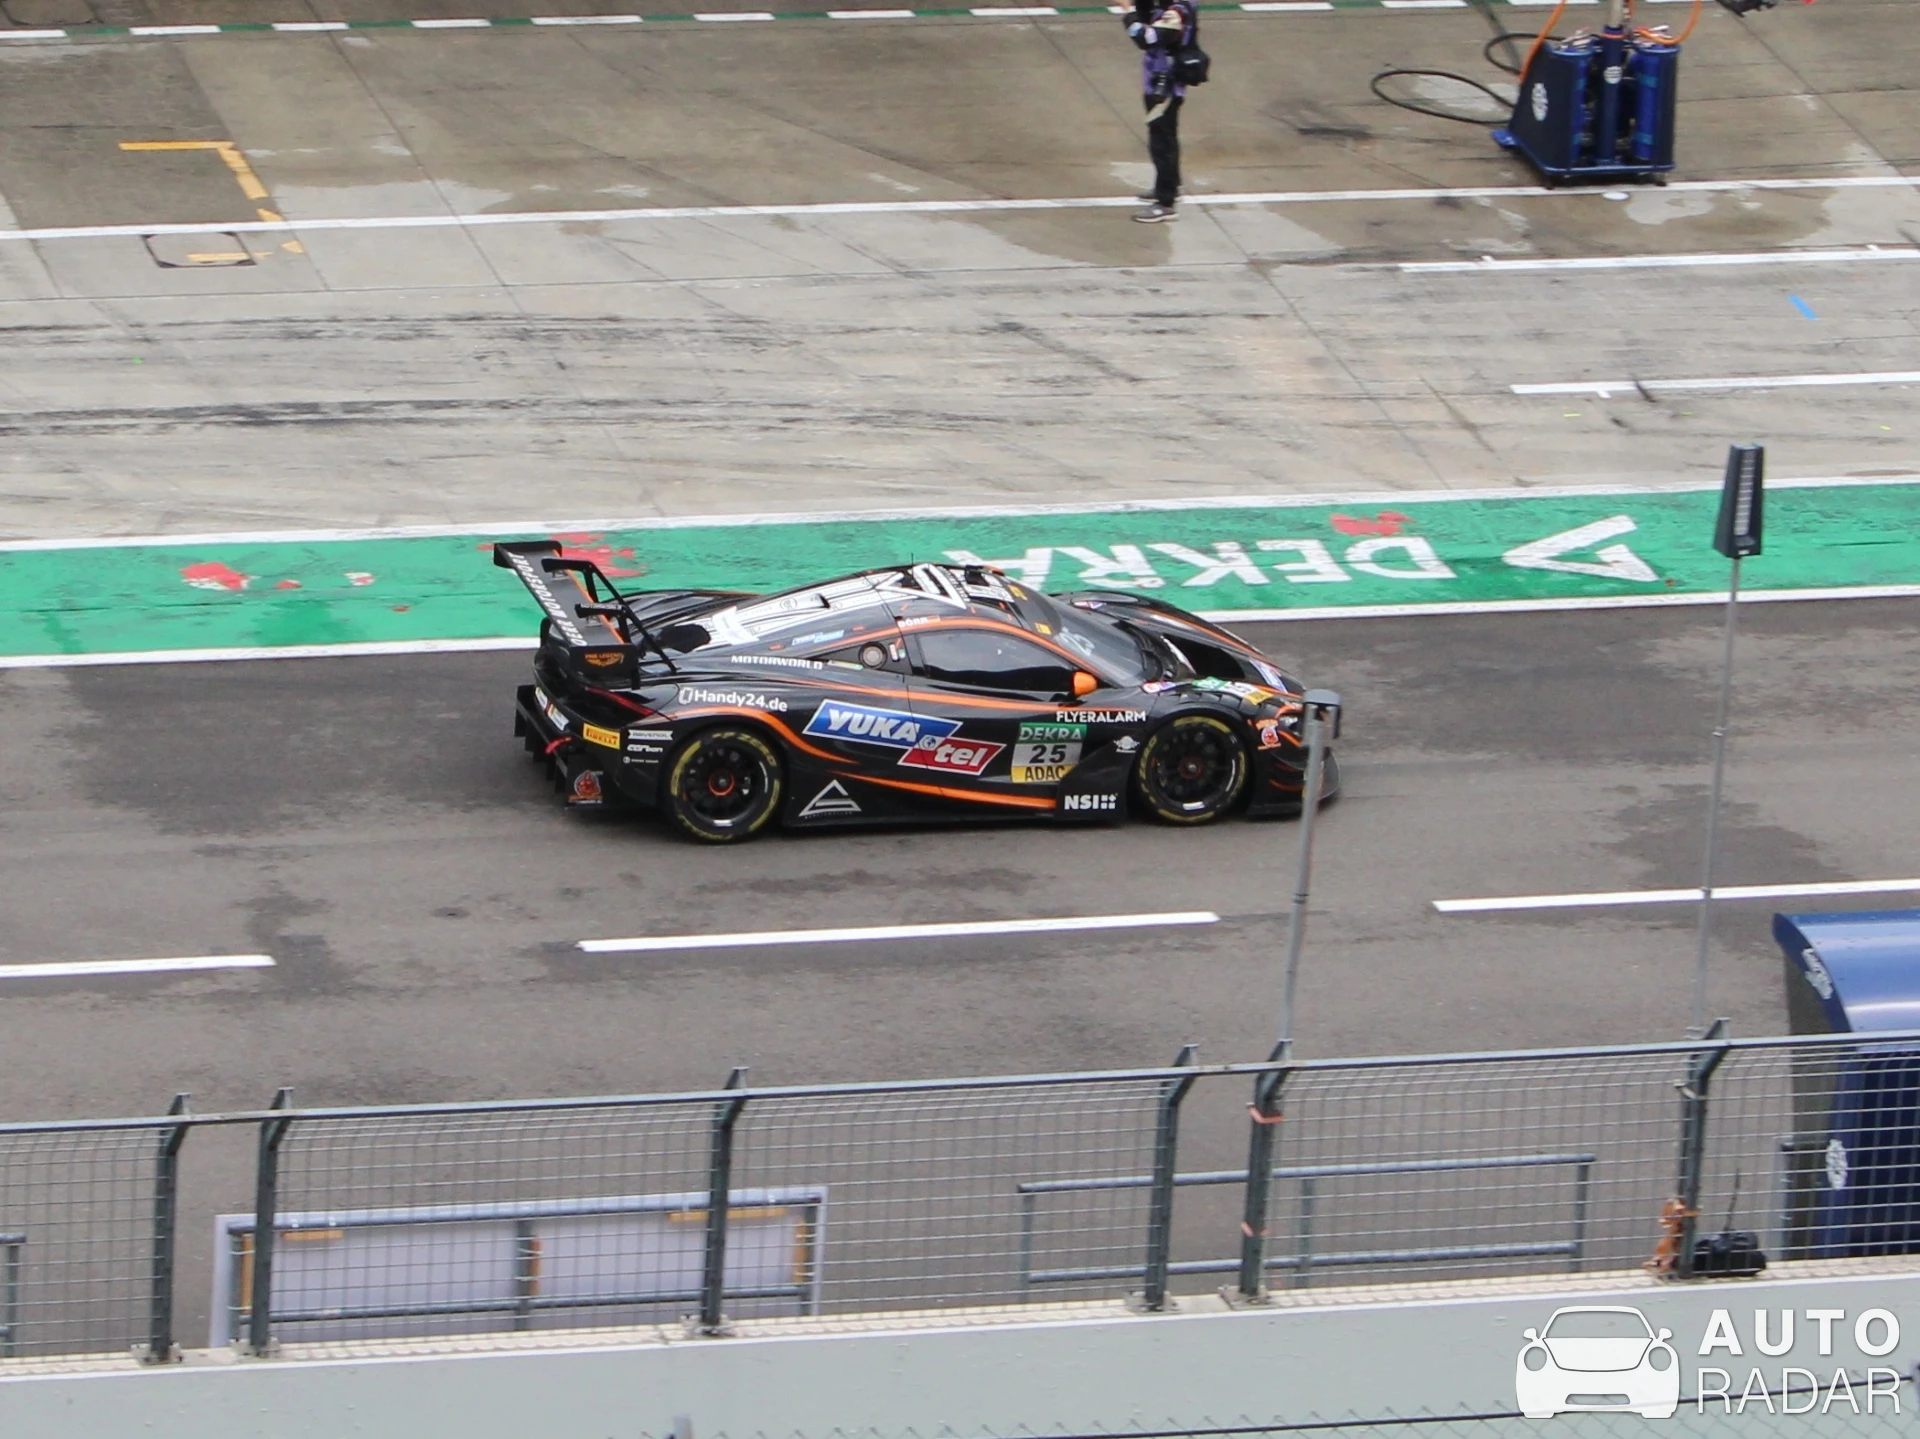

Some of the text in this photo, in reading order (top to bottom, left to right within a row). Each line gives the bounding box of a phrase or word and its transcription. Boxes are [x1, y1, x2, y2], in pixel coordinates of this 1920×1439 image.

[942, 536, 1456, 589] DEKRA
[507, 551, 568, 619] MOTORSPORT
[731, 655, 824, 670] MOTORWORLD
[694, 688, 788, 712] Handy24.de
[827, 708, 920, 743] YUKA
[1056, 710, 1147, 724] FLYERALARM
[586, 727, 618, 745] PIRELLI
[1019, 726, 1083, 742] DEKRA
[936, 742, 988, 767] tel
[1031, 744, 1067, 763] 25
[1024, 766, 1066, 782] ADAC
